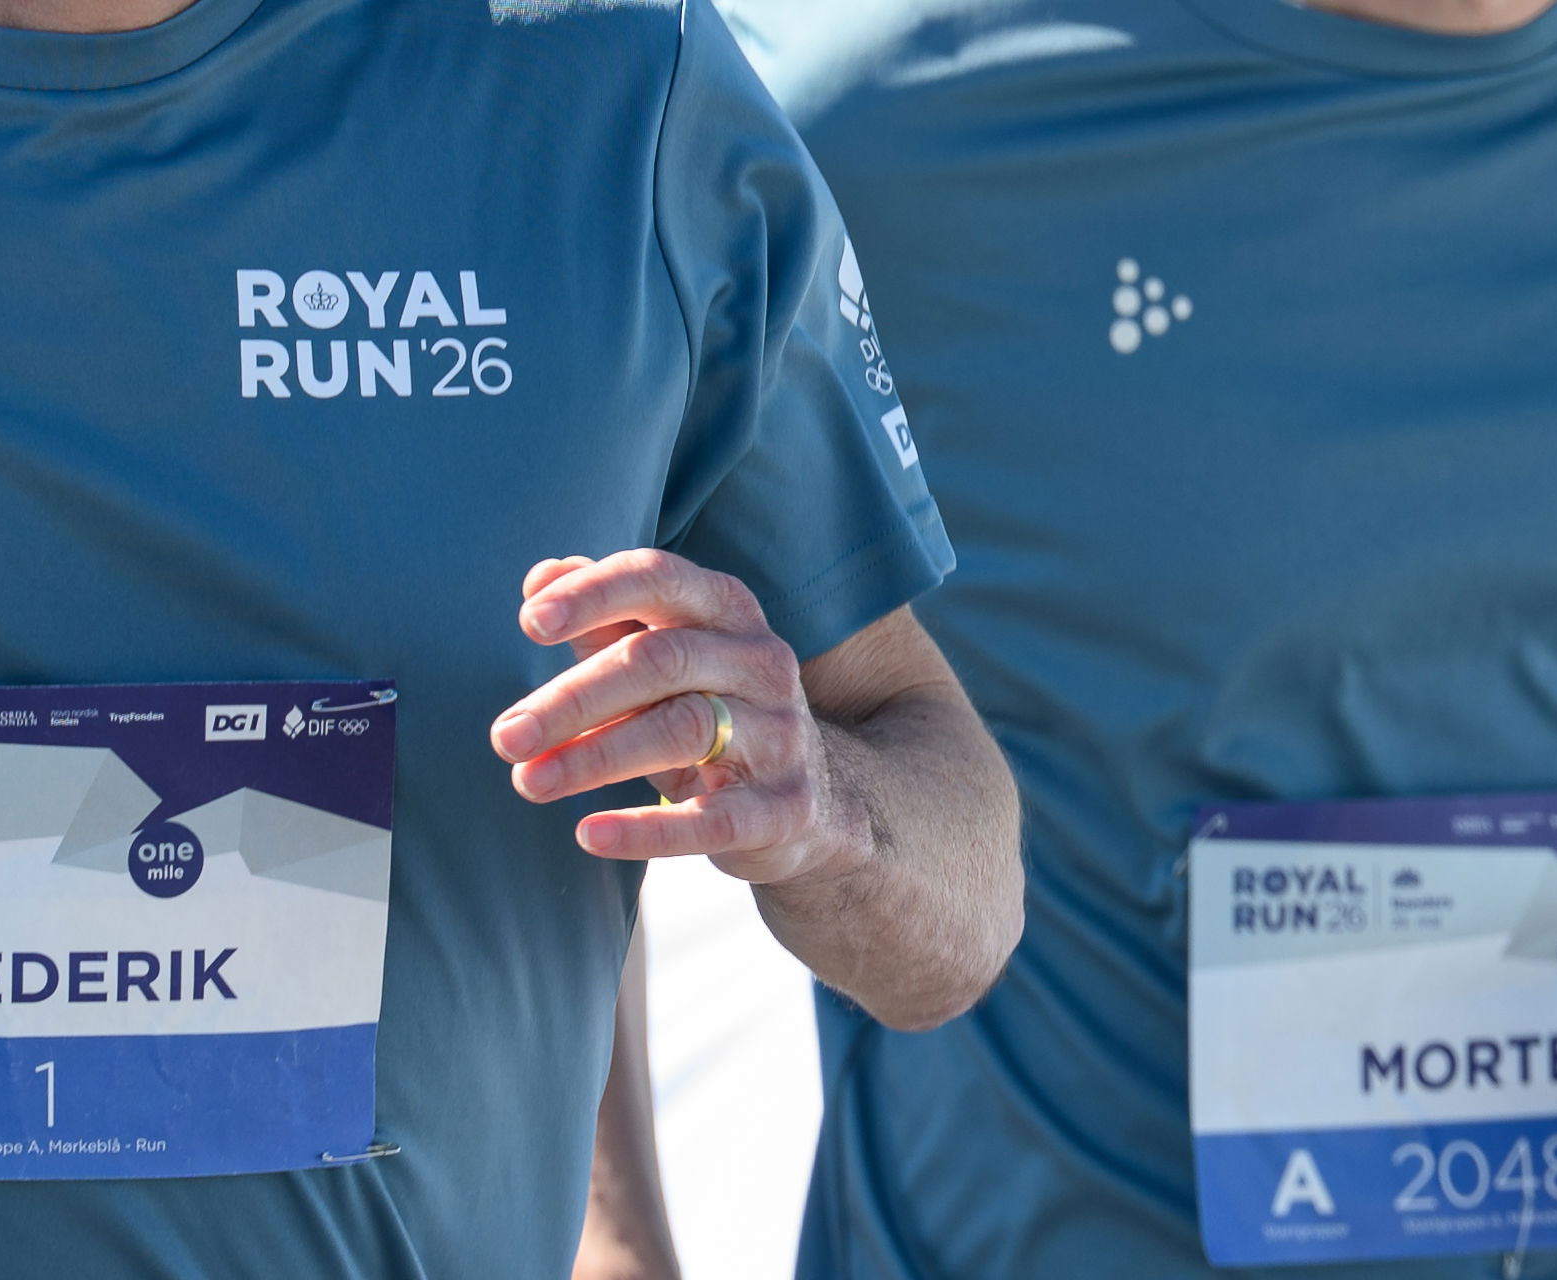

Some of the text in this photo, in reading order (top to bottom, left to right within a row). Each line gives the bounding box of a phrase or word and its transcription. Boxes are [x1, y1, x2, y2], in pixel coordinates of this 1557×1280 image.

[236, 269, 507, 329] ROYAL
[240, 338, 413, 398] RUN
[212, 714, 260, 732] DGI
[308, 719, 336, 737] DIF
[138, 841, 195, 862] one
[147, 864, 185, 880] mile
[1234, 865, 1366, 895] ROYAL
[34, 1061, 55, 1128] 1
[27, 1139, 44, 1156] A,
[49, 1136, 122, 1154] Mørkeblå
[136, 1138, 167, 1153] Run
[1271, 1147, 1336, 1218] A
